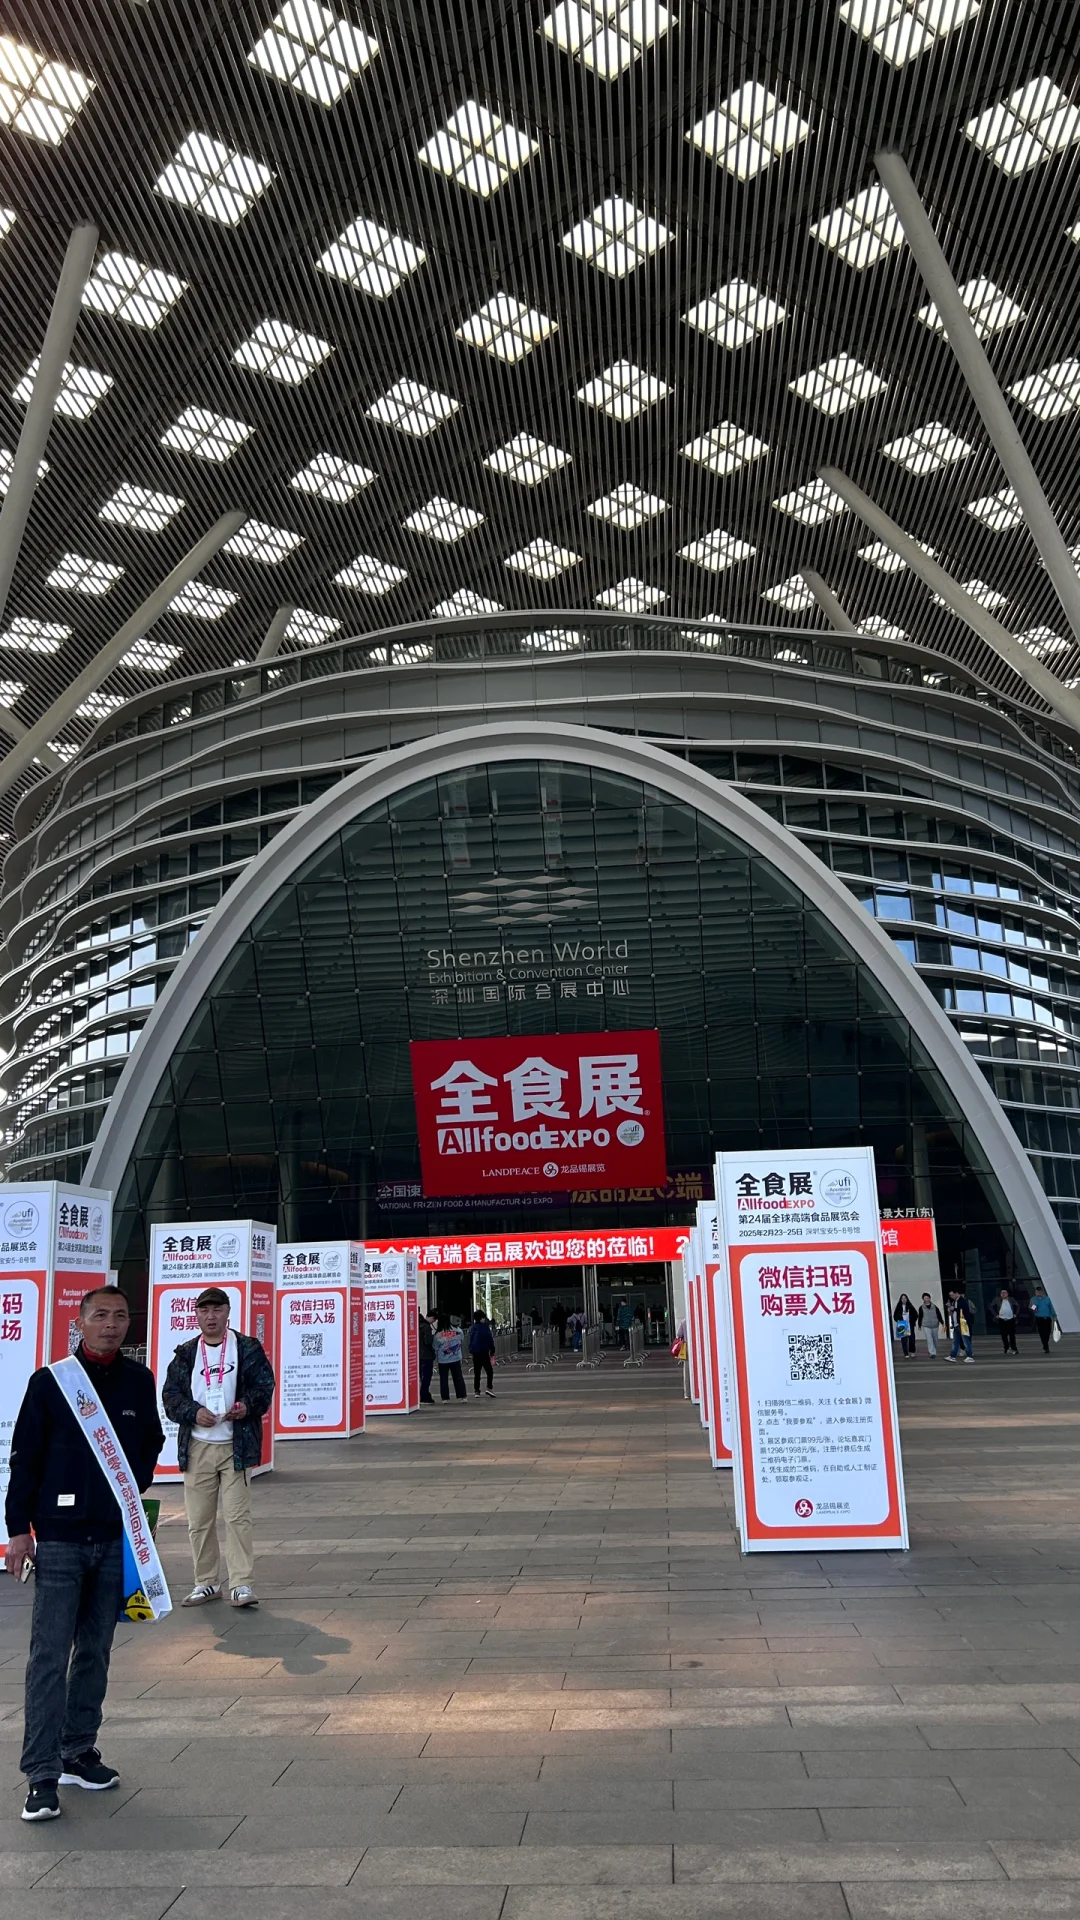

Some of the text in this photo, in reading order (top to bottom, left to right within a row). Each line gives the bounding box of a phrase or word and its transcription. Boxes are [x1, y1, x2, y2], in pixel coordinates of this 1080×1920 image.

[427, 939, 628, 968] Shenzhen World
[428, 964, 629, 984] Exhibition & Convention Center
[430, 979, 630, 1005] 深圳国际会展中心
[430, 1053, 644, 1124] 全食展
[482, 1167, 540, 1177] LANDPEACE
[735, 1171, 813, 1197] 全食展
[443, 1200, 463, 1208] FOOD
[59, 1202, 89, 1228] 全食展
[738, 1211, 860, 1225] 第24届全球高端食品展览会
[878, 1207, 934, 1218] 录大厅(东)
[0, 1241, 37, 1252] 品展览会
[162, 1235, 212, 1253] 全食展
[282, 1252, 321, 1266] 全食展
[758, 1265, 852, 1289] 微信扫码
[289, 1299, 335, 1312] 微信扫码
[364, 1300, 395, 1311] 信扫码
[760, 1292, 855, 1317] 购票入场
[289, 1312, 335, 1326] 购票入场
[364, 1311, 395, 1322] 票入场
[1, 1319, 22, 1341] 场
